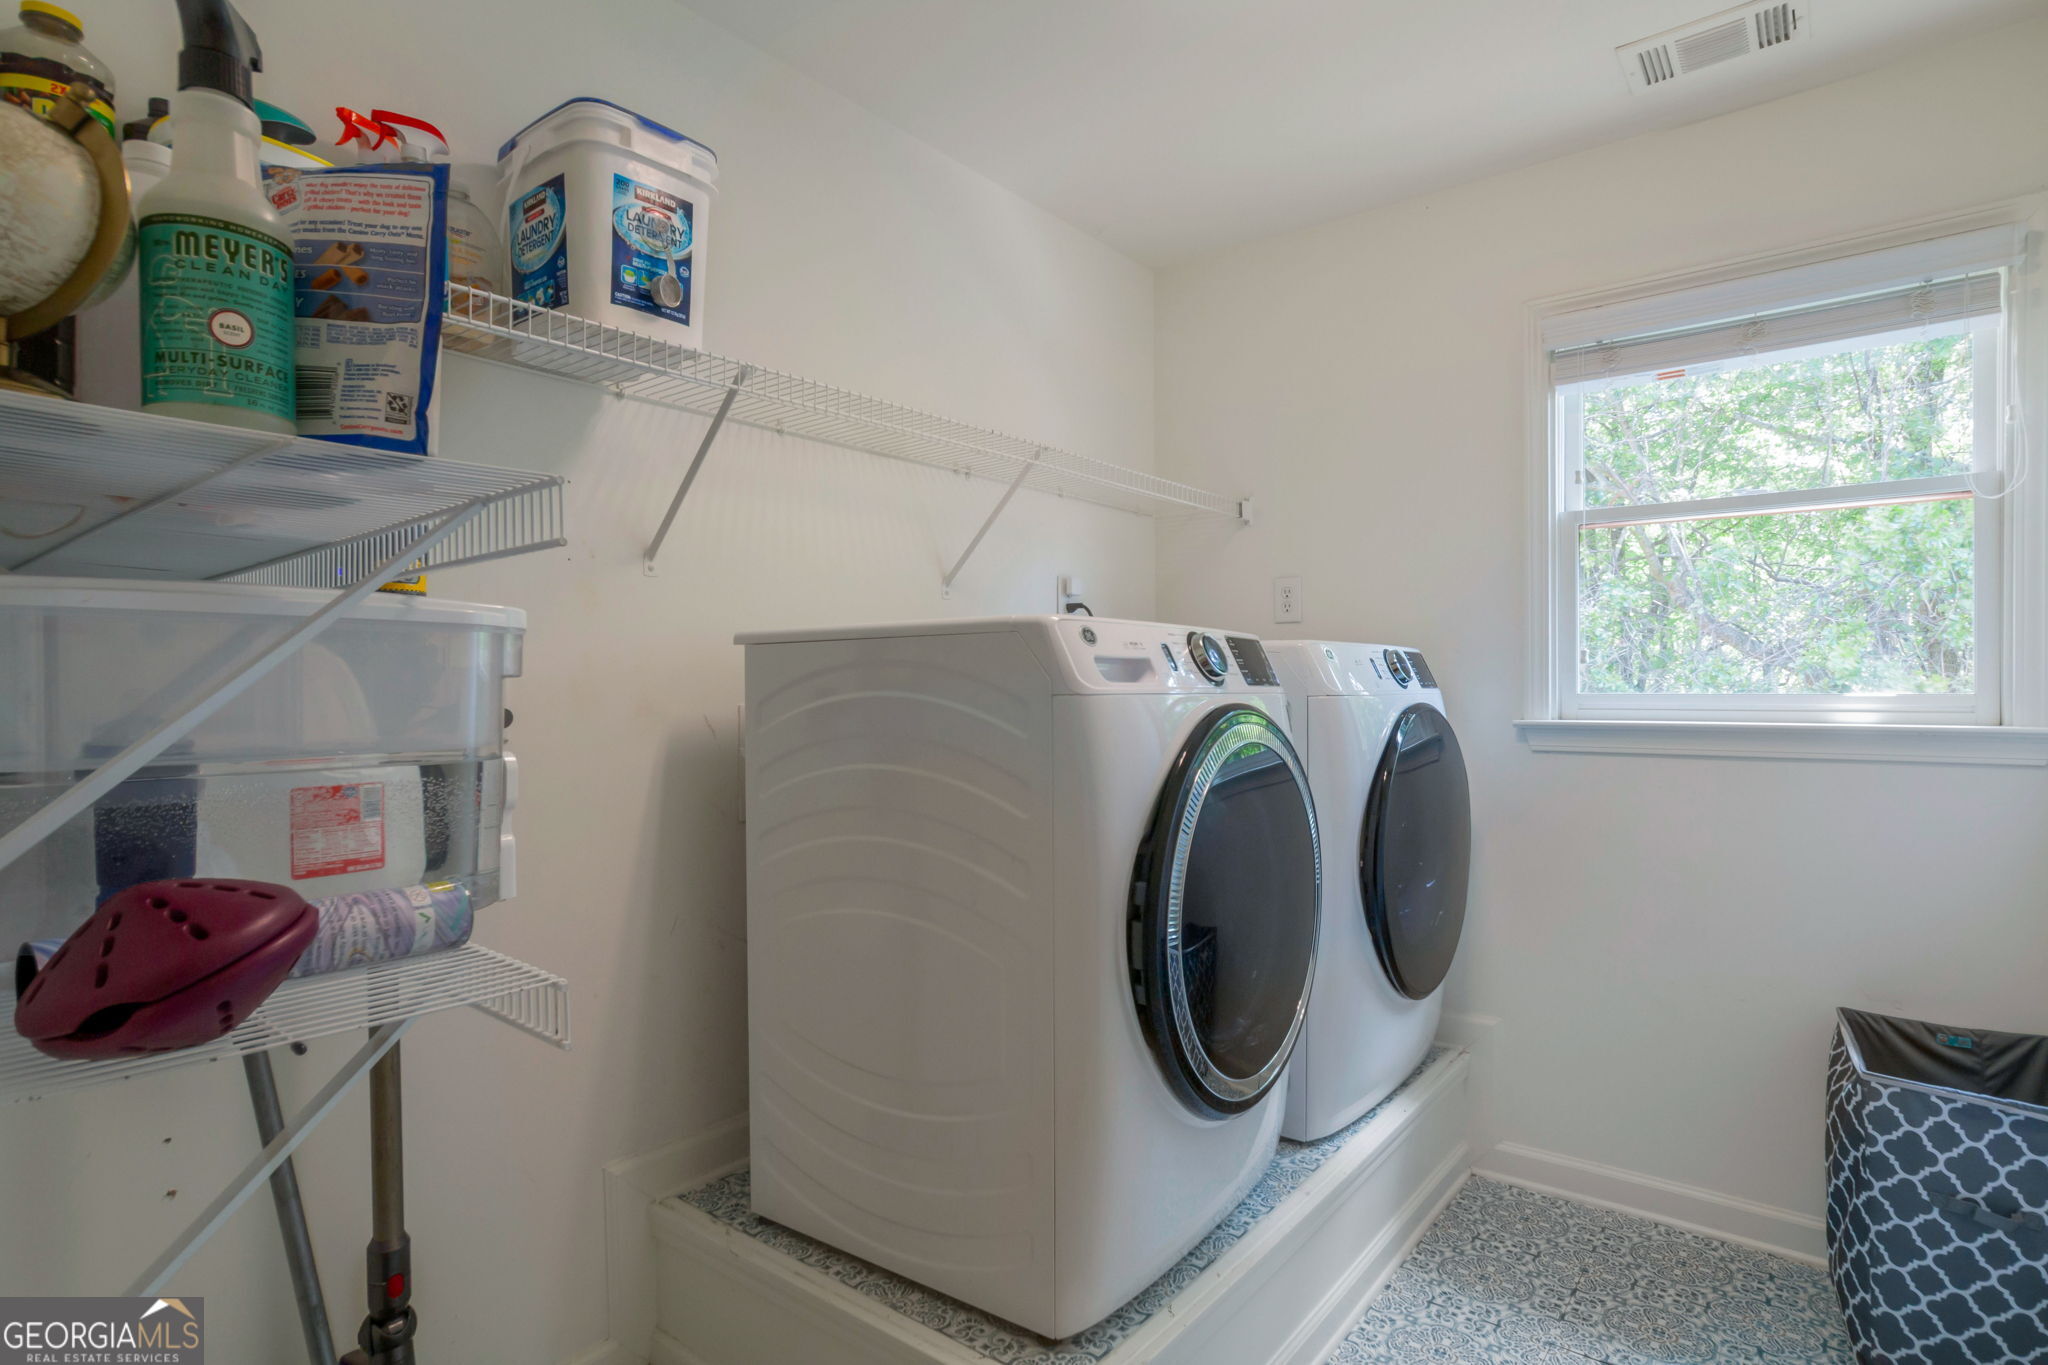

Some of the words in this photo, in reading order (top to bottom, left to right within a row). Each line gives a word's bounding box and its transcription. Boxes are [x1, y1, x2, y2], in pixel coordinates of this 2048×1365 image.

[636, 187, 677, 208] KIRKLAND
[517, 213, 556, 245] LAUNDRY
[518, 230, 554, 258] DETERGENT
[173, 229, 289, 284] MEYER'S
[174, 259, 251, 281] CLEAN
[259, 277, 289, 294] DAY
[218, 321, 246, 334] BASIL
[154, 350, 289, 383] MULTI-SURFACE
[154, 364, 228, 378] EVERYDAY
